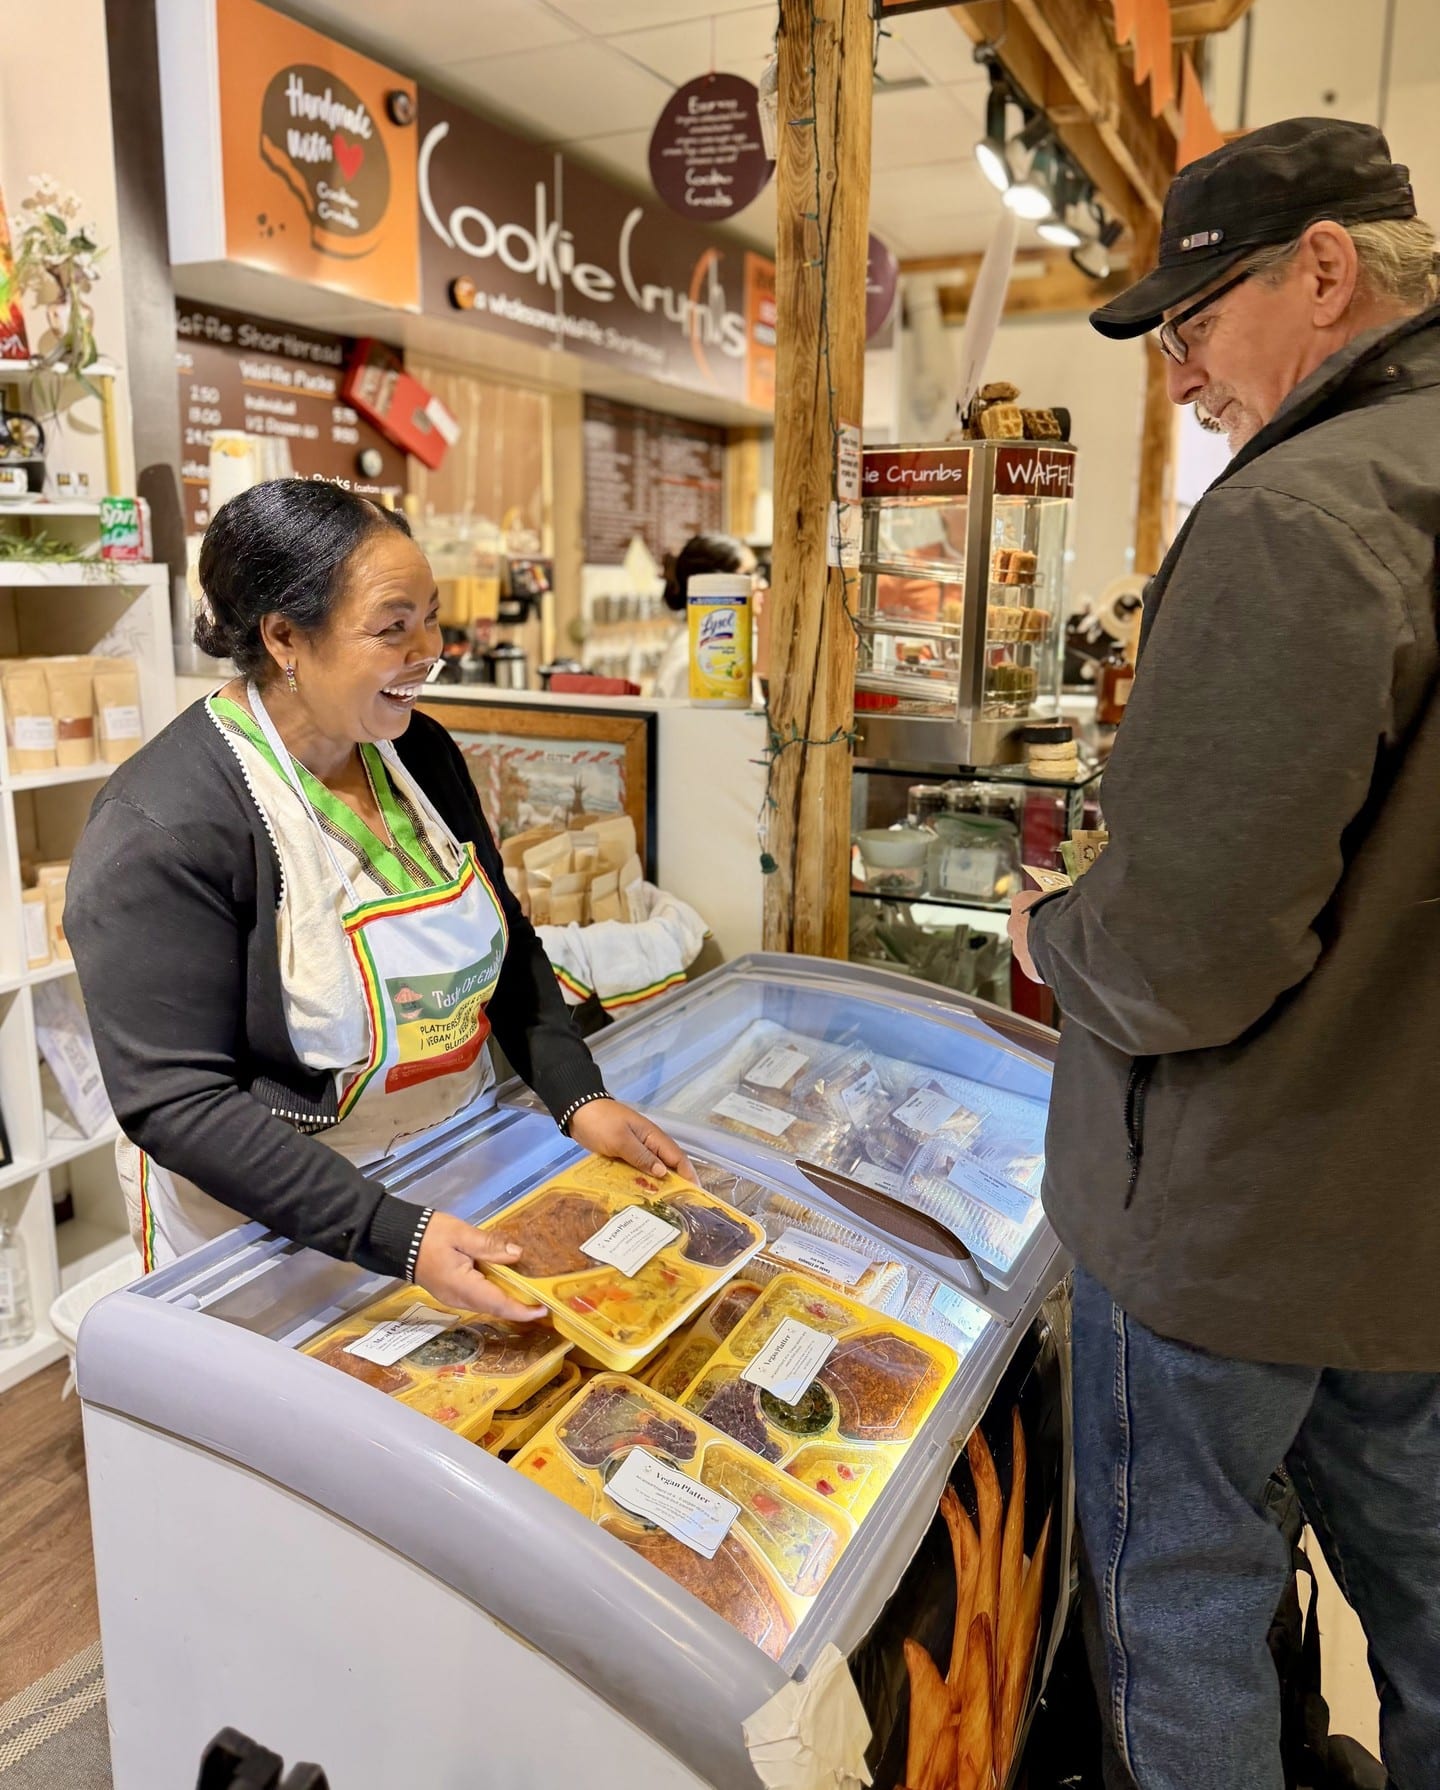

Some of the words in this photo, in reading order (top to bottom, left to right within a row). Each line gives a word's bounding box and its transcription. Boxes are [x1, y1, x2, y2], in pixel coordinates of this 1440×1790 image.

[418, 121, 615, 302] Cookie
[619, 207, 748, 358] Crumbs
[886, 463, 963, 483] Crumbs
[701, 611, 735, 636] Lysol
[426, 1033, 452, 1047] VEGAN
[656, 1471, 681, 1488] Vegan
[681, 1484, 711, 1504] Platter
